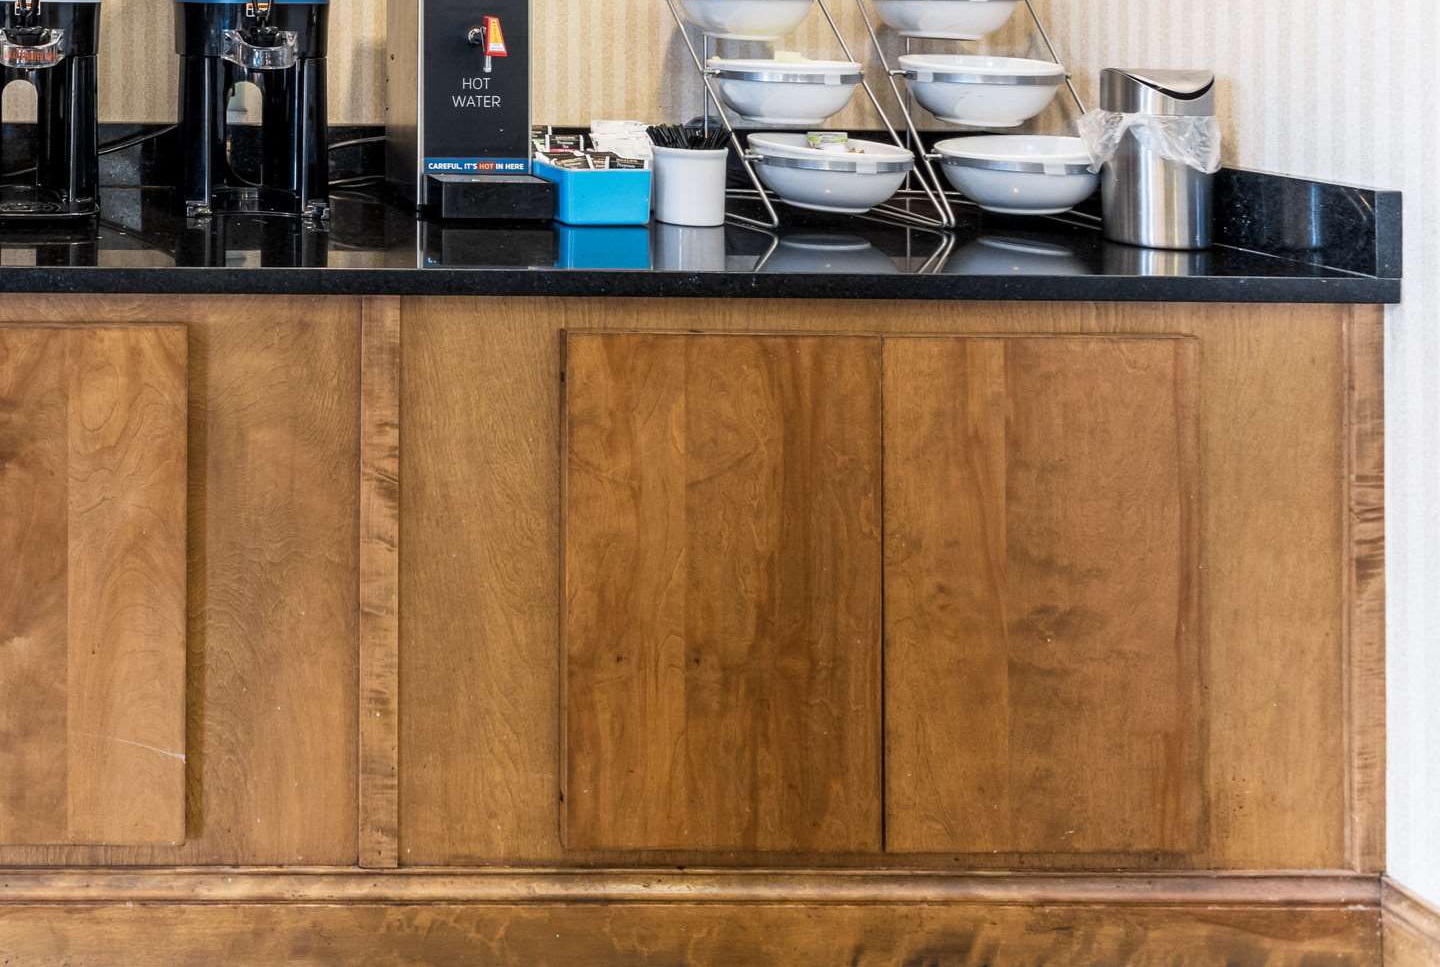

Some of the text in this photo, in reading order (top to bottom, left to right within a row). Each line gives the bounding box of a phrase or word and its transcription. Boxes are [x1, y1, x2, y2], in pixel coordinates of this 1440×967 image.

[462, 77, 491, 90] HOT
[452, 95, 501, 107] WATER
[428, 162, 462, 170] CAREFUL,
[464, 162, 478, 170] IT'S
